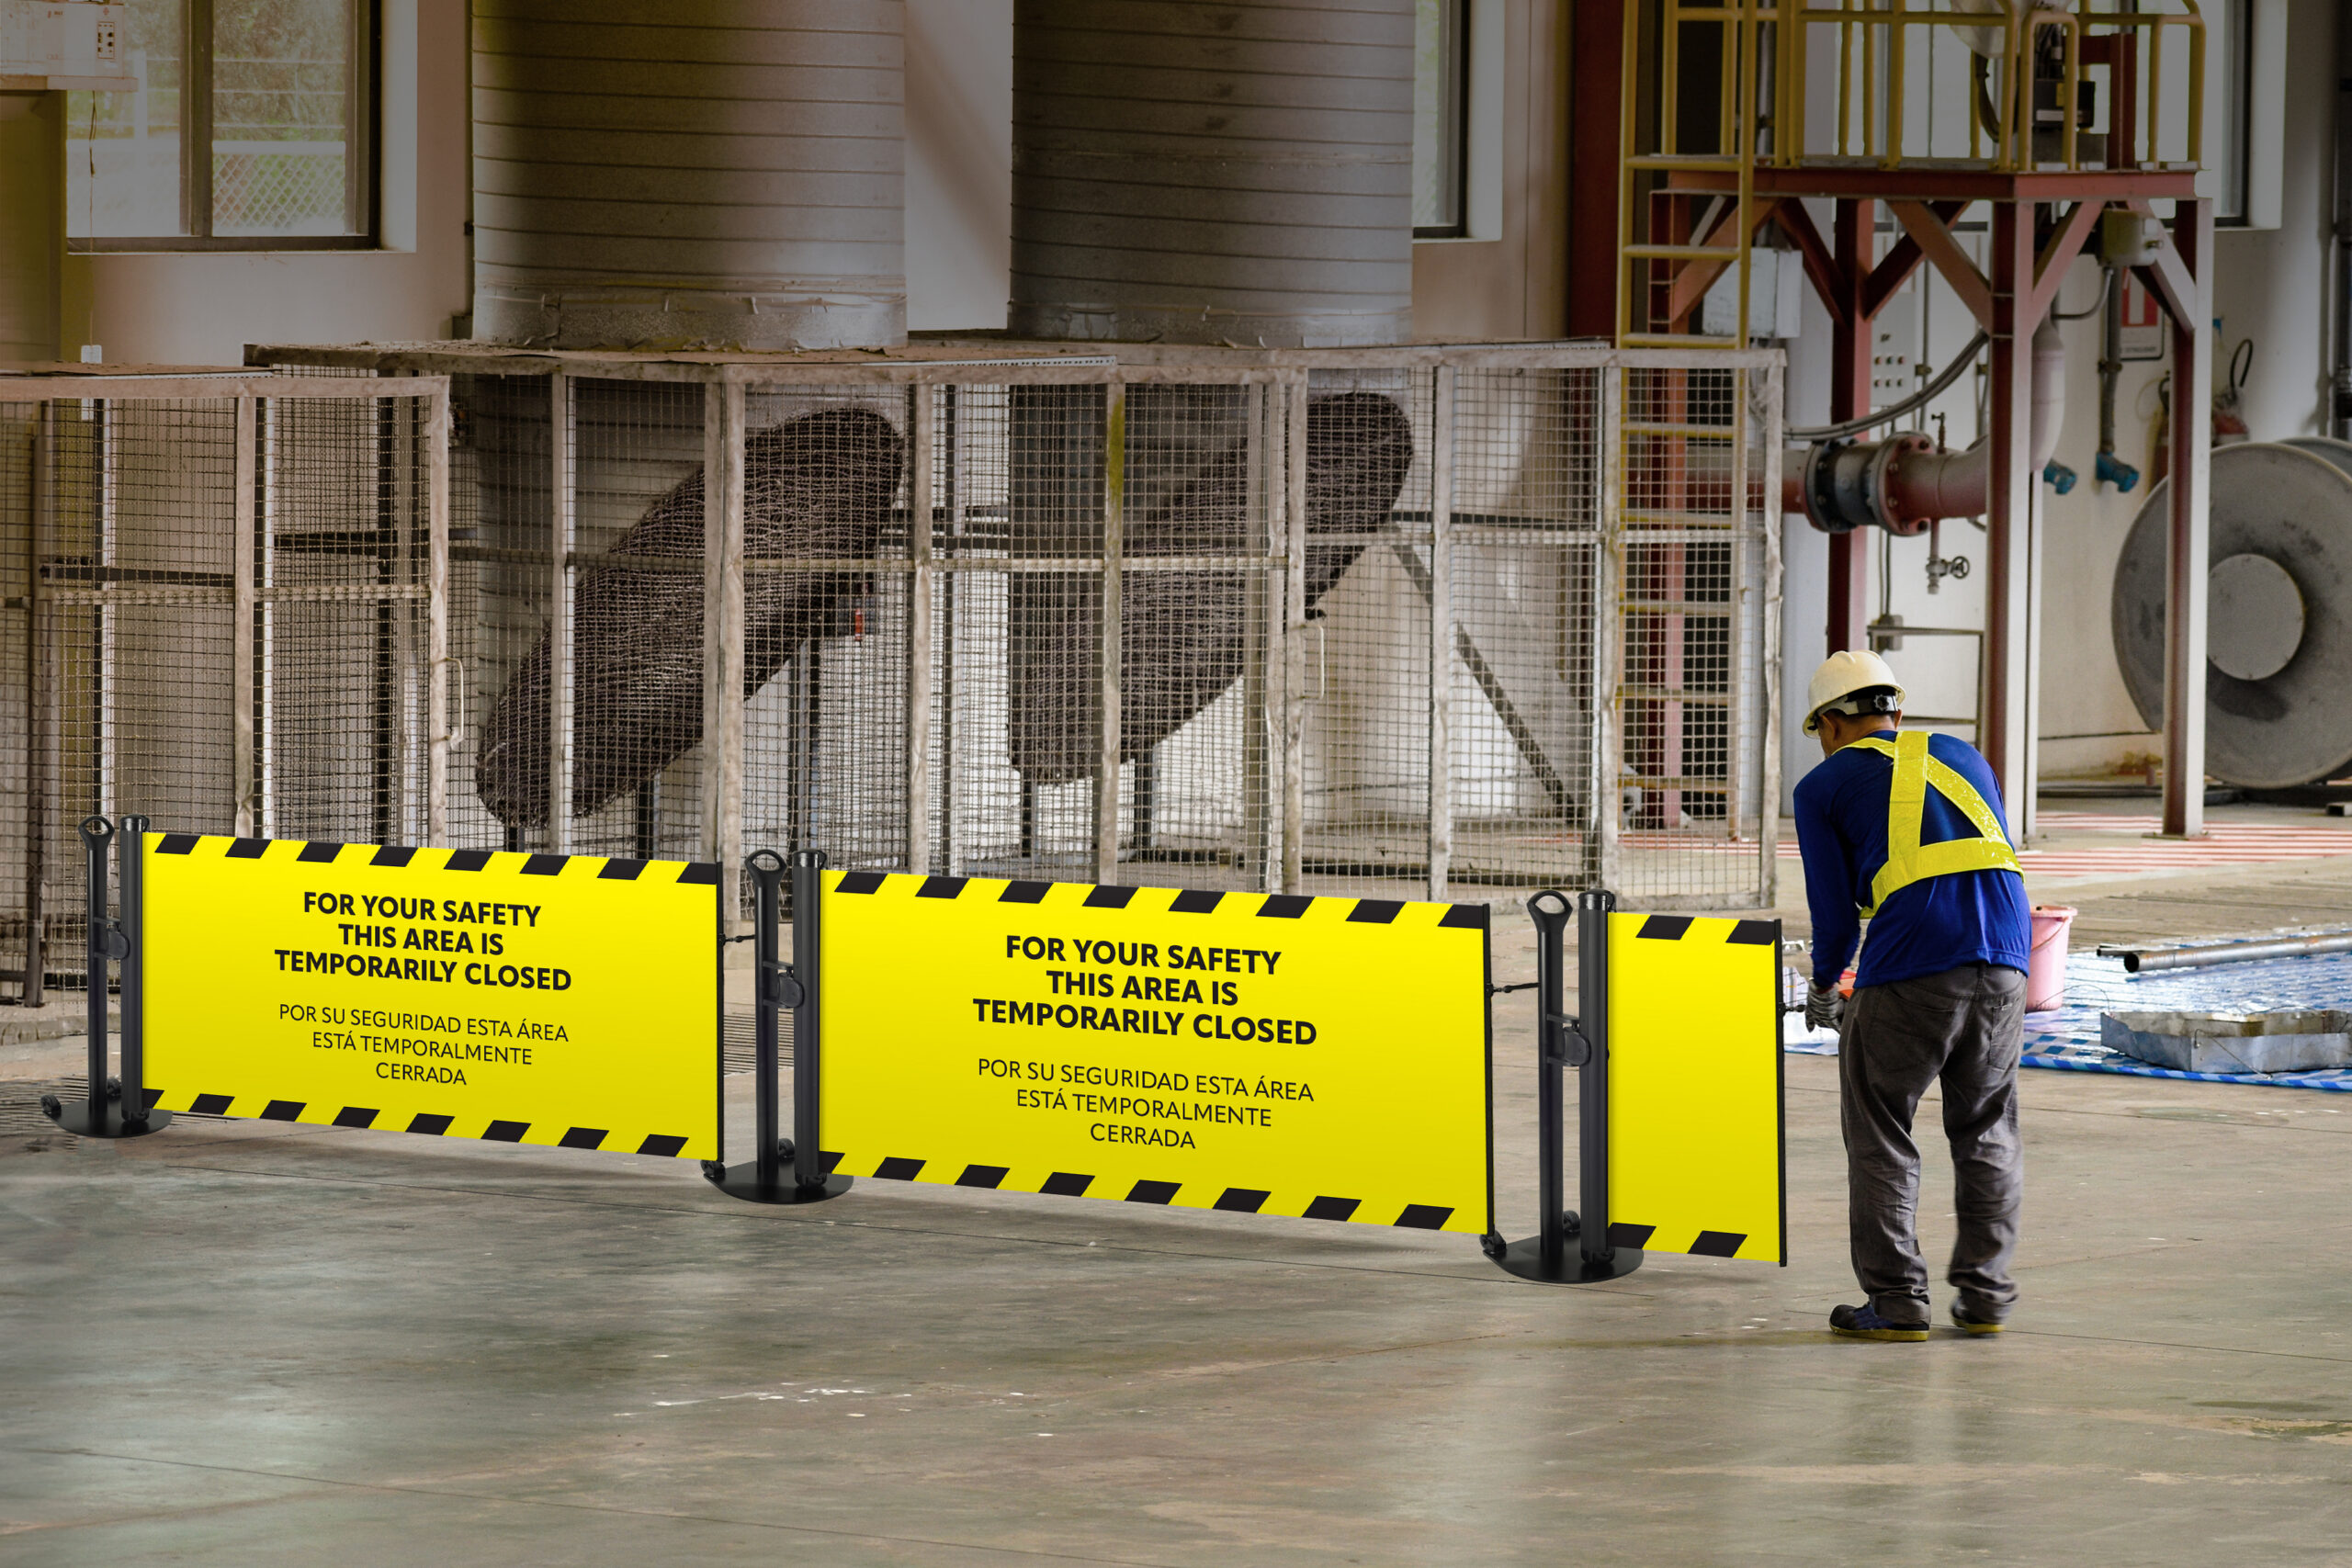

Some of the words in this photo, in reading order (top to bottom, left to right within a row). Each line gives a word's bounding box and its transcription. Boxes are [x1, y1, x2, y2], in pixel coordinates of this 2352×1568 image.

[305, 892, 356, 915] FOR
[361, 896, 436, 920] YOUR
[444, 900, 541, 927] SAFETY
[338, 924, 396, 948] THIS
[403, 929, 473, 953] AREA
[482, 933, 503, 955] IS
[1007, 935, 1066, 961] FOR
[1073, 940, 1159, 967] YOUR
[1168, 945, 1281, 975] SAFETY
[275, 950, 457, 982] TEMPORARILY
[465, 963, 571, 990] CLOSED
[1046, 970, 1114, 997] THIS
[1122, 976, 1204, 1003] AREA
[1213, 981, 1238, 1006] IS
[280, 1004, 316, 1021] POR
[322, 1007, 345, 1024] SU
[351, 1010, 460, 1032] SEGURIDAD
[468, 1019, 513, 1037] ESTA
[517, 1019, 568, 1042] ÁREA
[973, 998, 1184, 1035] TEMPORARILY
[1193, 1014, 1317, 1044] CLOSED
[313, 1031, 356, 1050] ESTÁ
[360, 1035, 531, 1065] TEMPORALMENTE
[377, 1063, 467, 1085] CERRADA
[979, 1059, 1021, 1078] POR
[1028, 1062, 1054, 1081] SU
[1061, 1065, 1188, 1090] SEGURIDAD
[1197, 1076, 1249, 1096] ESTA
[1254, 1076, 1314, 1101] ÁREA
[1018, 1089, 1067, 1110] ESTÁ
[1072, 1094, 1271, 1126] TEMPORALMENTE
[1091, 1123, 1195, 1149] CERRADA
